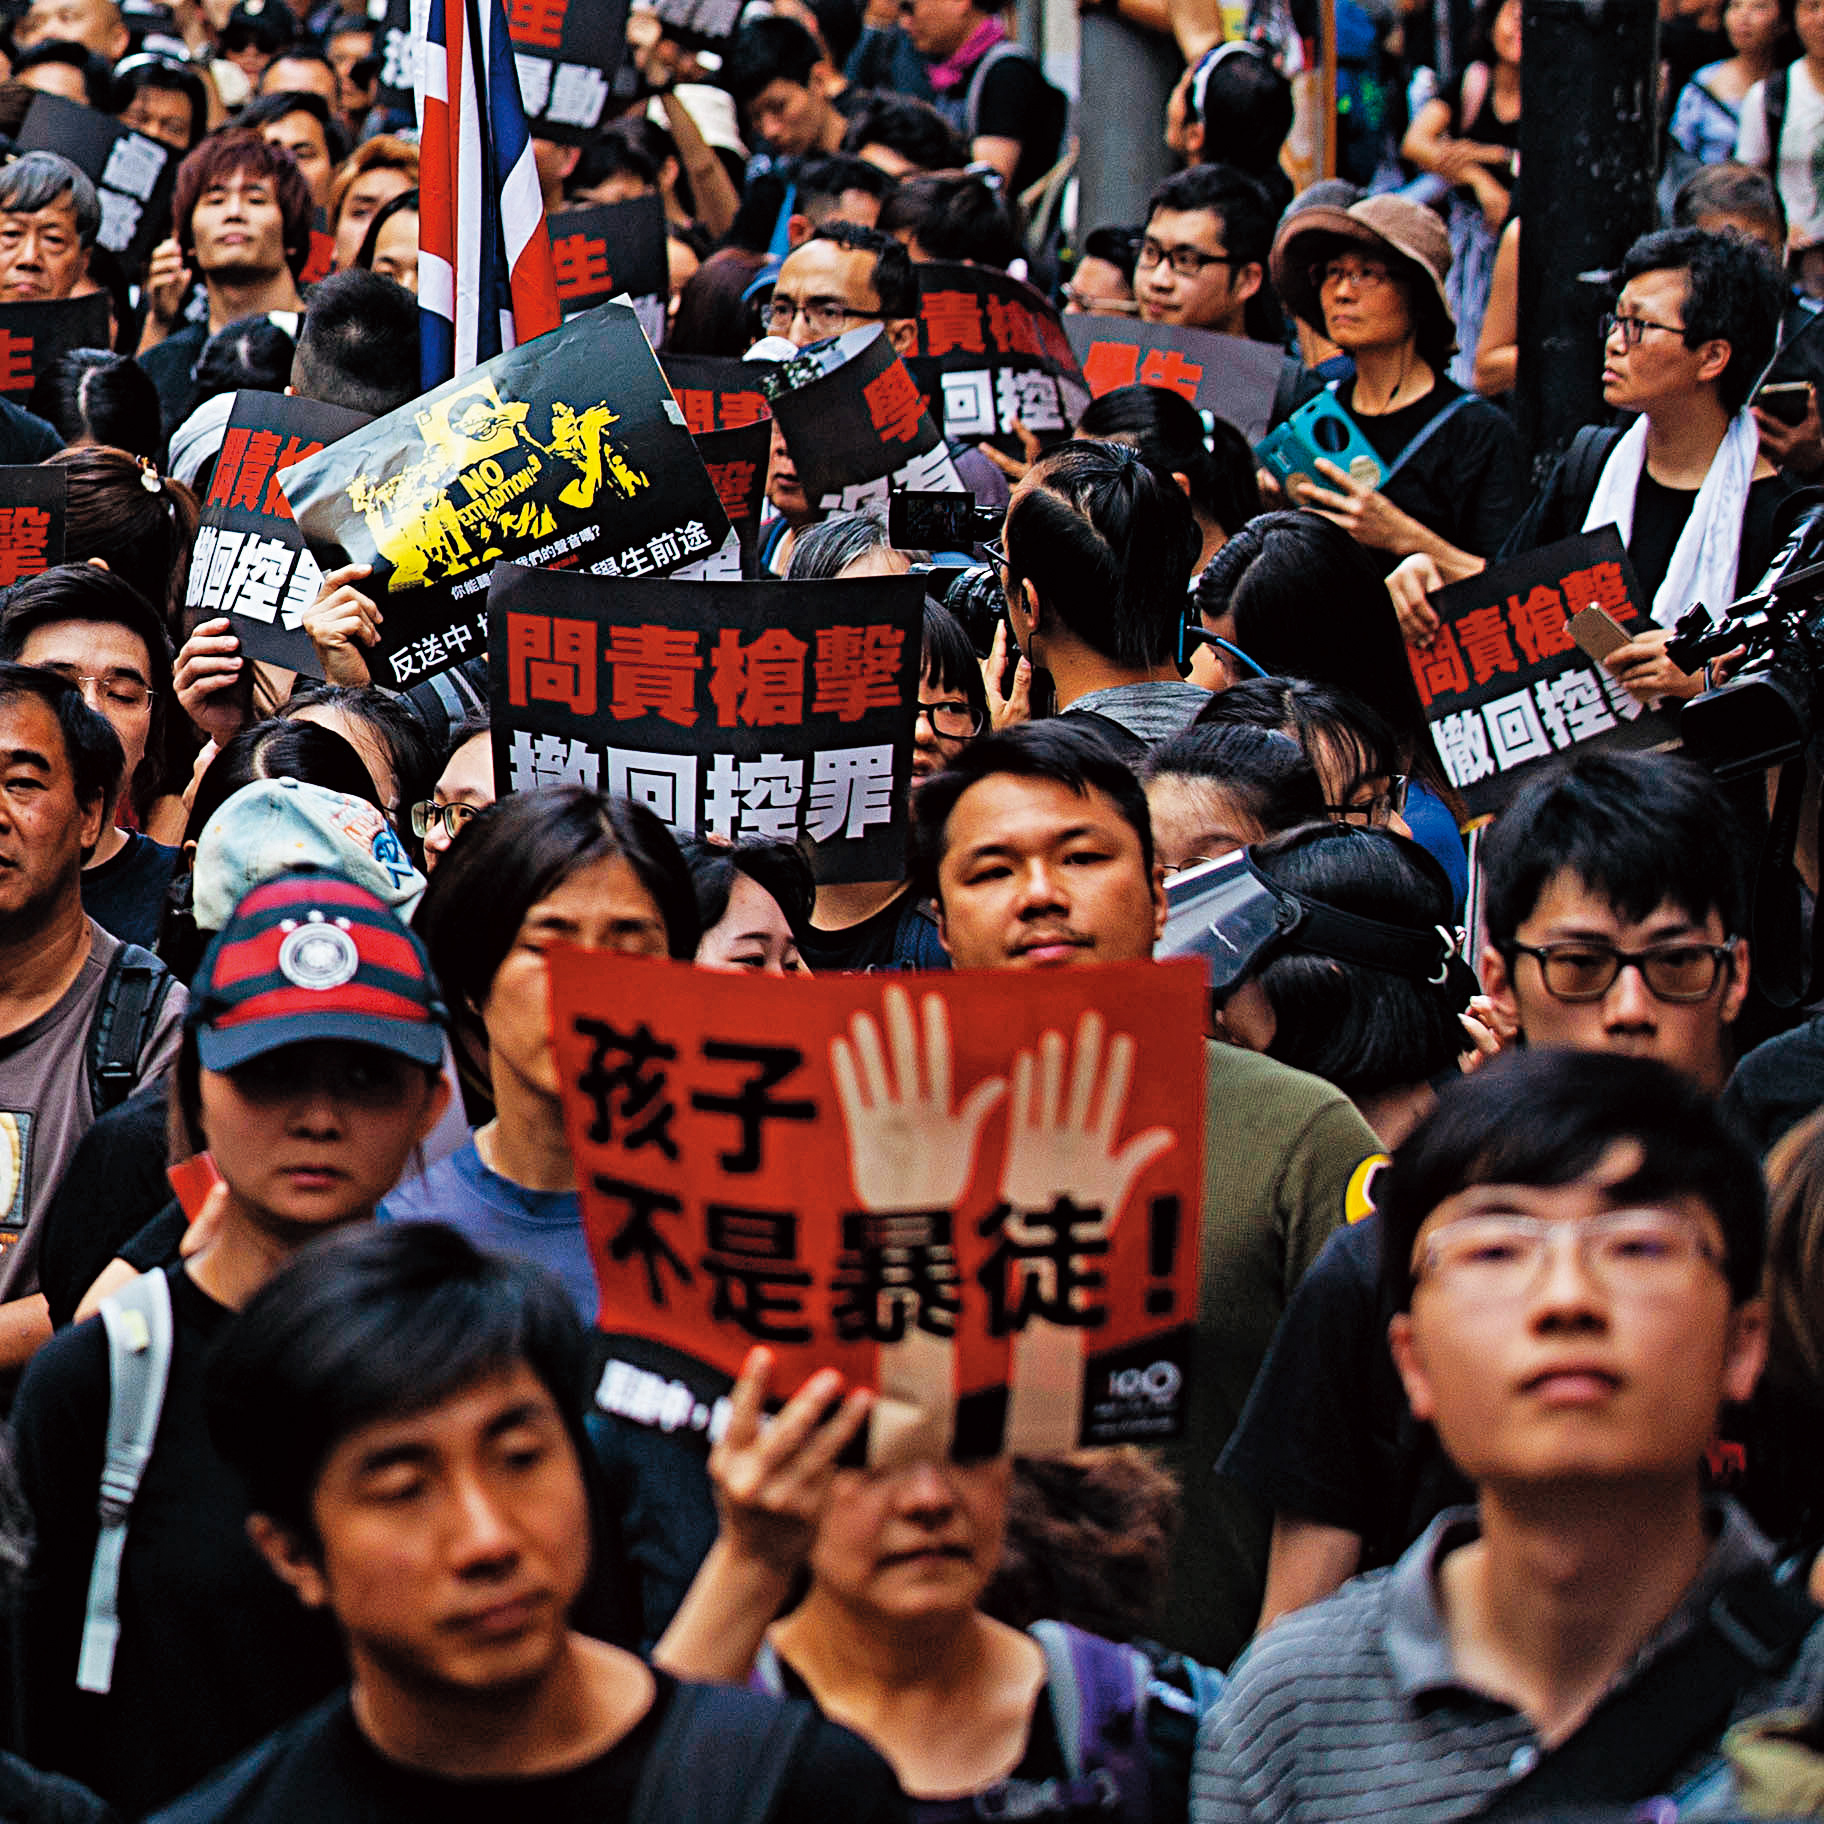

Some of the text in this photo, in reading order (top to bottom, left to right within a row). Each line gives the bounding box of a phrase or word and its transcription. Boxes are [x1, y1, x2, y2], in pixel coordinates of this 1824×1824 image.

[459, 457, 505, 500] NO
[506, 610, 904, 732] 問責槍擊
[569, 1009, 820, 1175] 孩子
